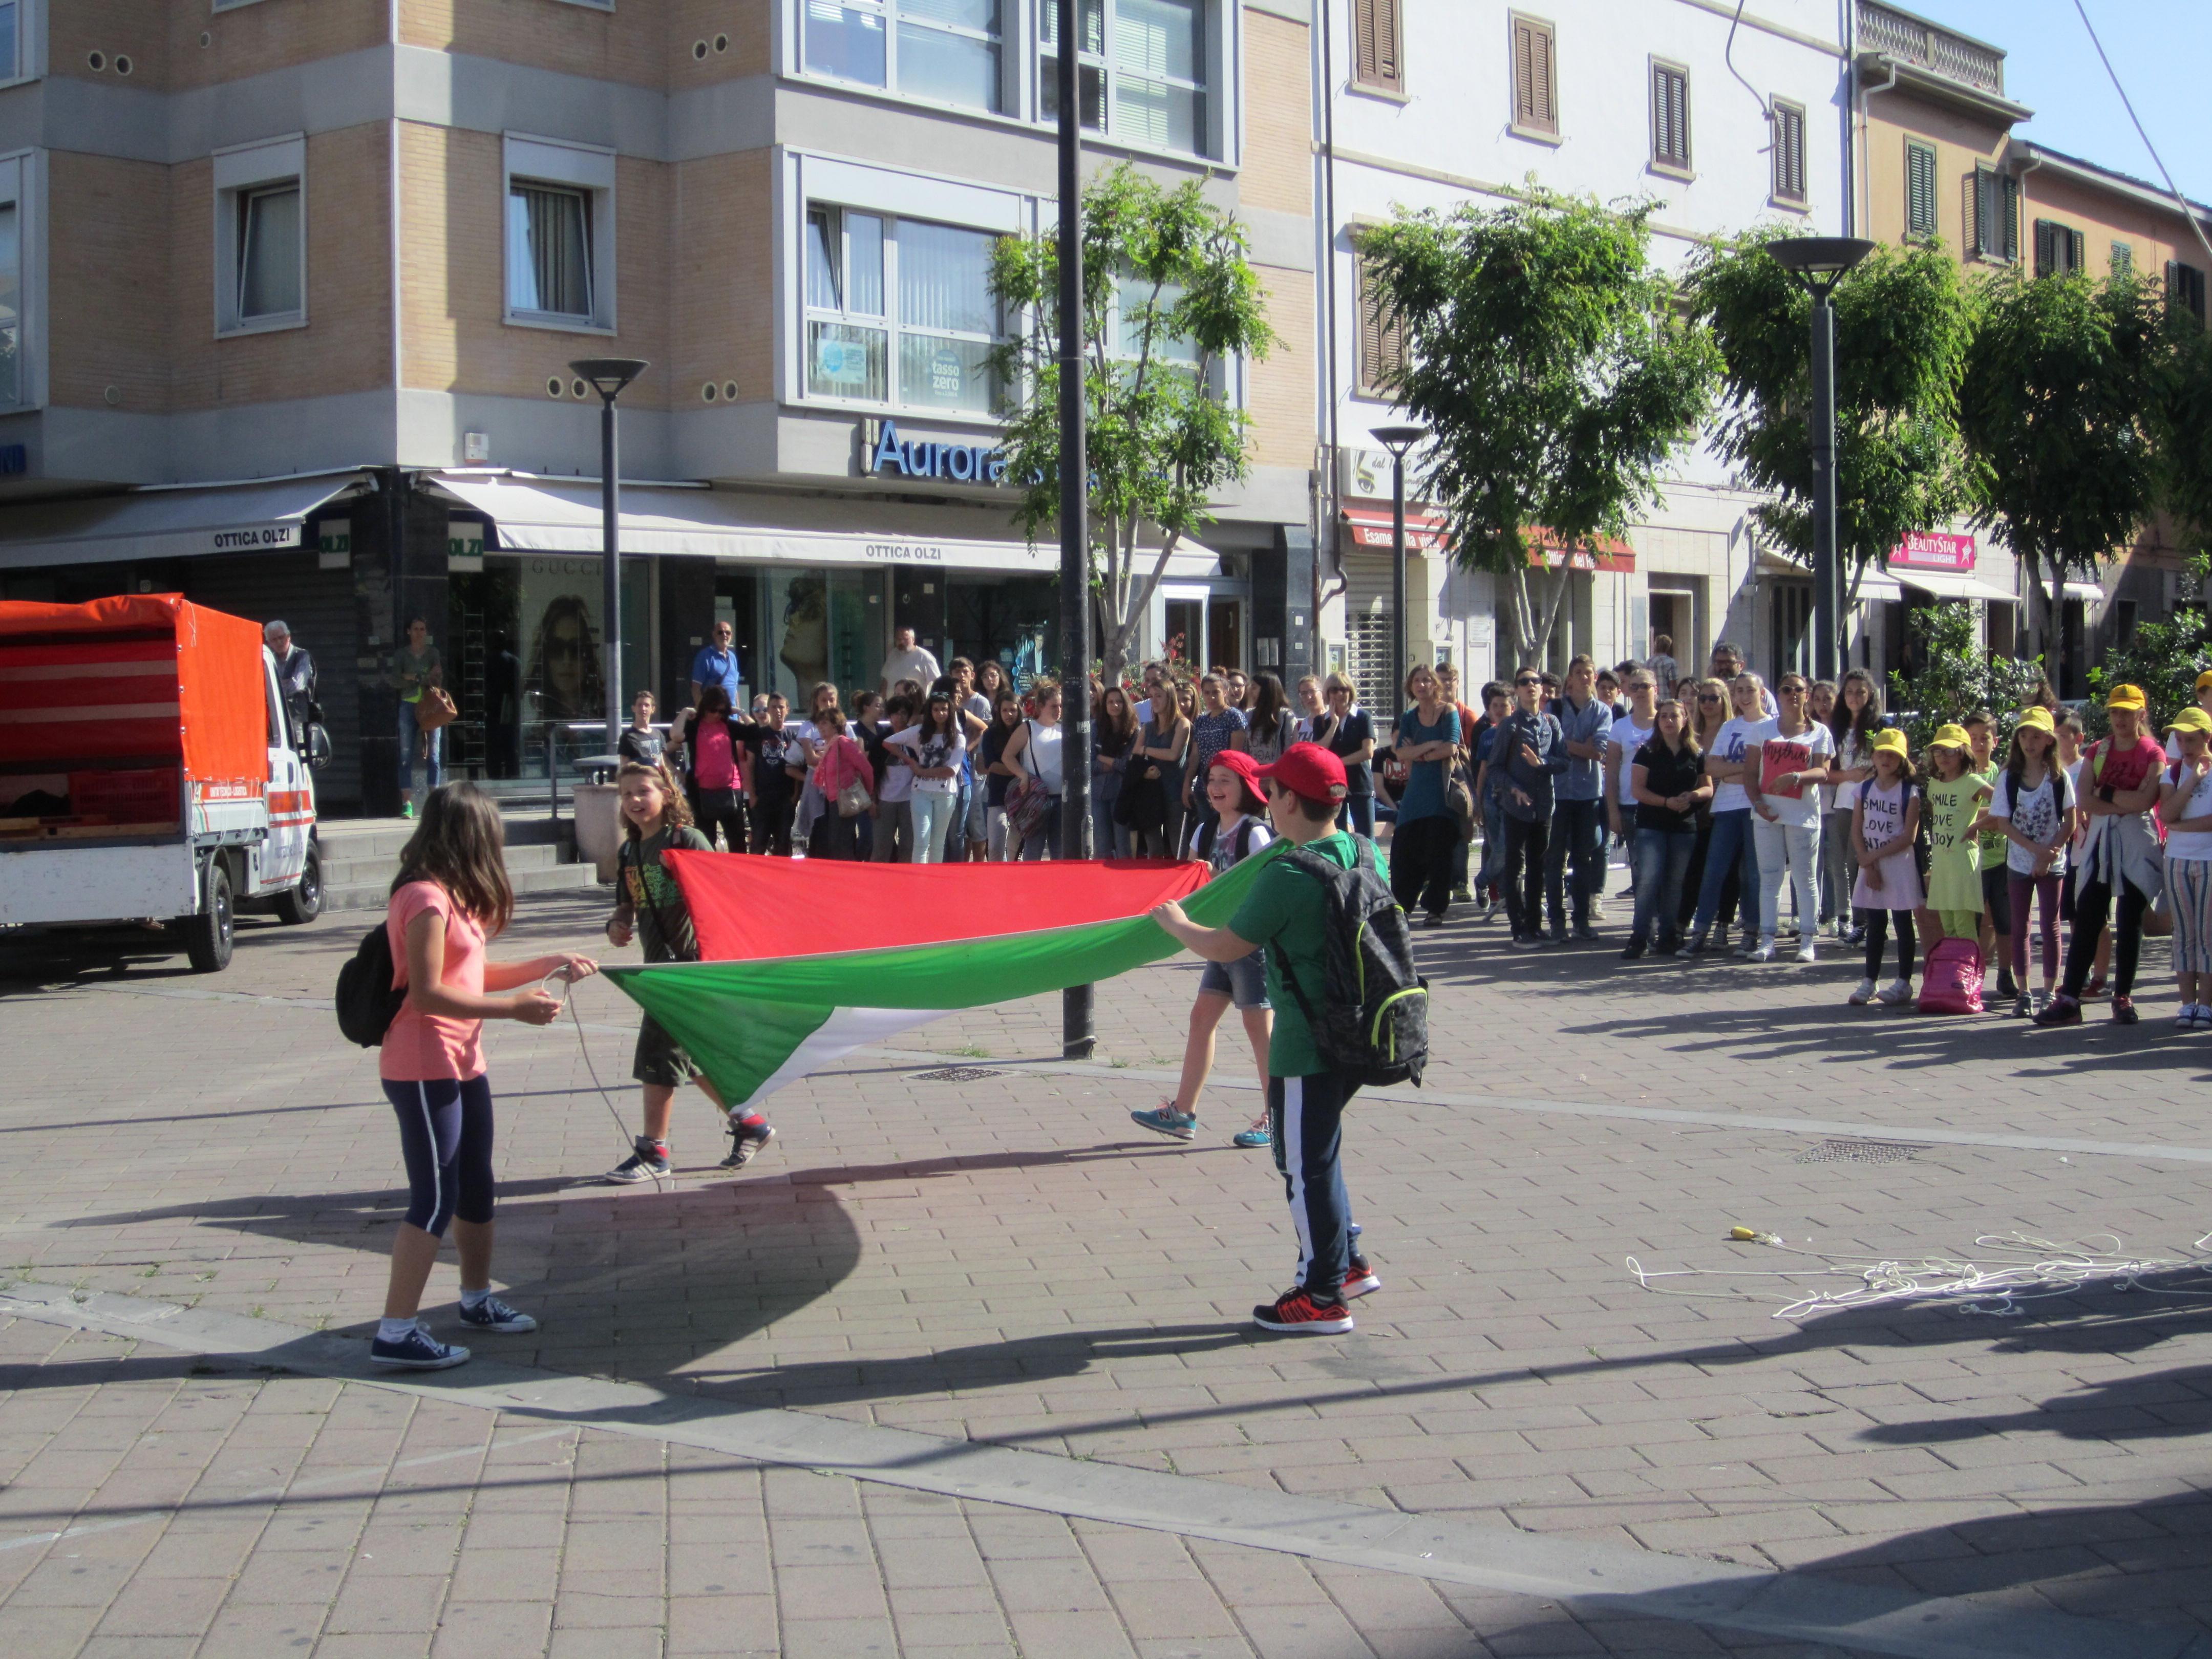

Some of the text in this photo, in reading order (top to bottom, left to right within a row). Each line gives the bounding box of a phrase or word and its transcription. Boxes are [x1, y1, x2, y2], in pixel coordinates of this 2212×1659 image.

[932, 361, 959, 376] tasso
[932, 375, 959, 391] zero
[873, 420, 1011, 482] Aurora
[1372, 457, 1386, 468] dal
[214, 527, 290, 548] OTTICA OLZI
[1364, 528, 1393, 545] Esame
[448, 537, 483, 557] OLZI
[866, 545, 941, 560] OTTICA OLZI
[1574, 552, 1585, 567] del
[1933, 555, 1956, 563] LIGHT
[532, 559, 600, 576] GUCCI
[1863, 798, 1897, 815] SMILE
[1932, 814, 1953, 826] OVE
